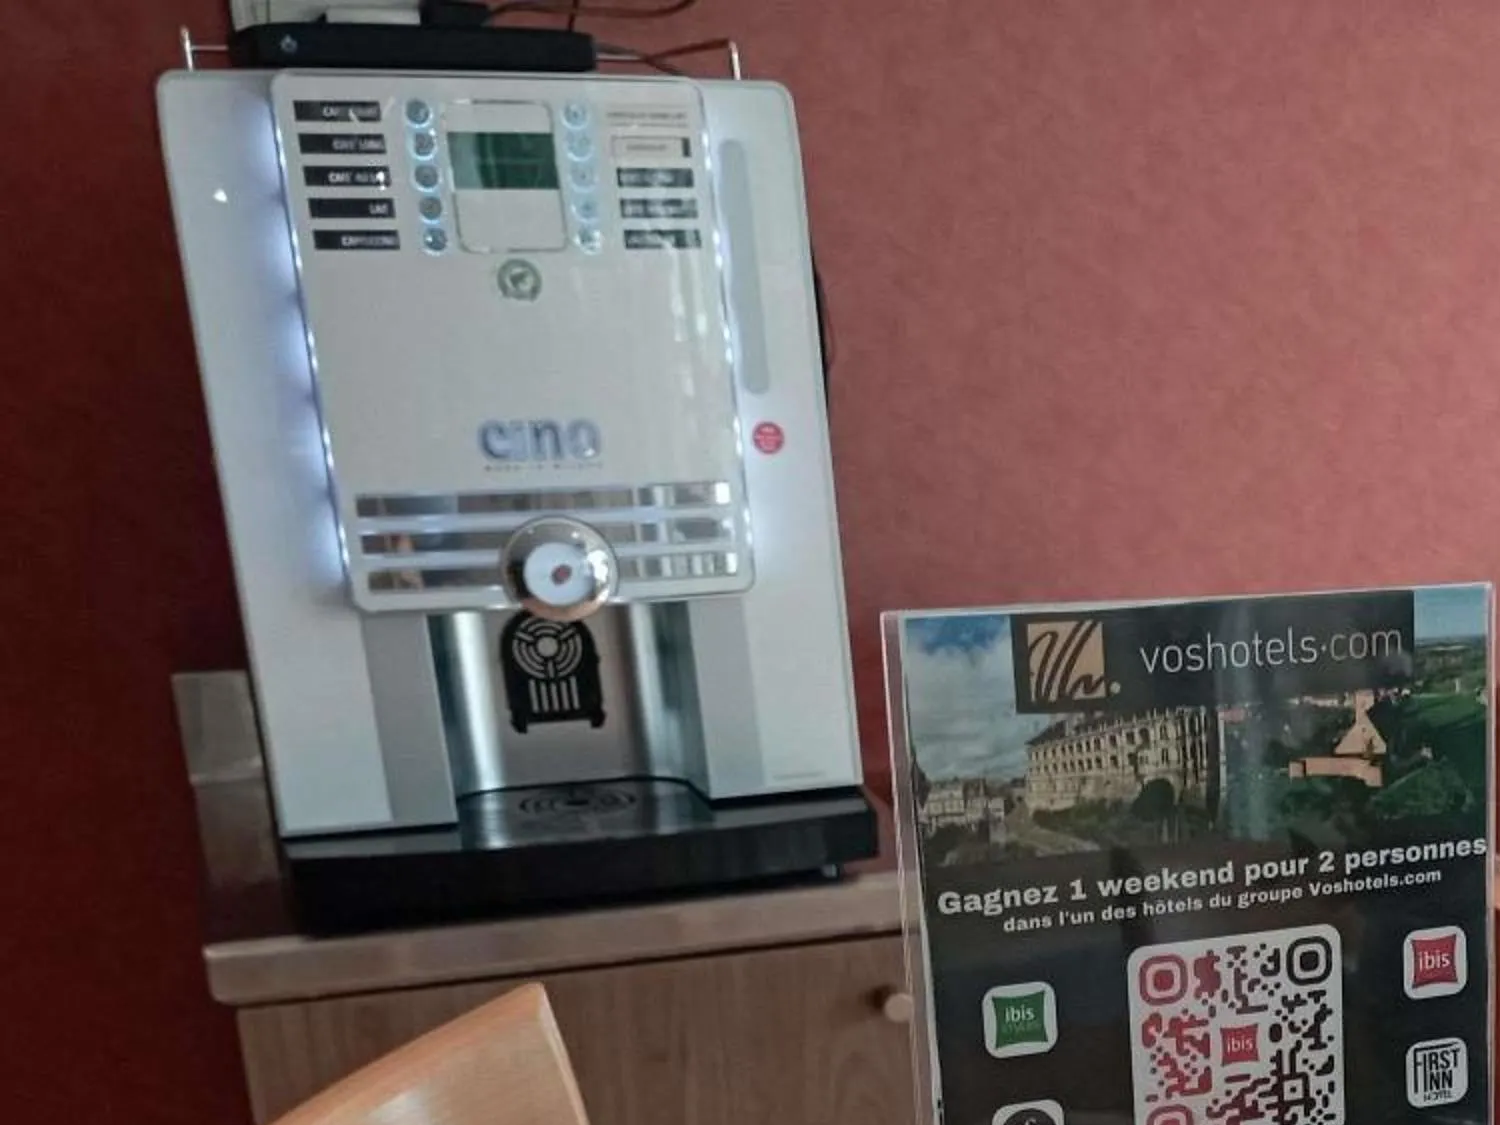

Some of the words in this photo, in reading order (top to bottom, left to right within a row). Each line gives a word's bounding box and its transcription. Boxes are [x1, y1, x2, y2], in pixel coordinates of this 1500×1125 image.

[937, 883, 1059, 917] Gagnez
[1069, 879, 1087, 901] 1
[1097, 862, 1235, 898] weekend
[1244, 857, 1310, 886] pour
[1318, 850, 1335, 873] 2
[1344, 837, 1488, 874] personnes
[1003, 916, 1052, 933] dans
[1101, 904, 1137, 922] des
[1142, 895, 1203, 917] hôtels
[1209, 892, 1232, 909] du
[1237, 886, 1303, 910] groupe
[1308, 869, 1442, 898] Voshotels.com
[1419, 950, 1451, 973] ibis
[1004, 1003, 1036, 1024] ibis
[1227, 1036, 1253, 1054] ibis
[1413, 1041, 1461, 1090] FIRST
